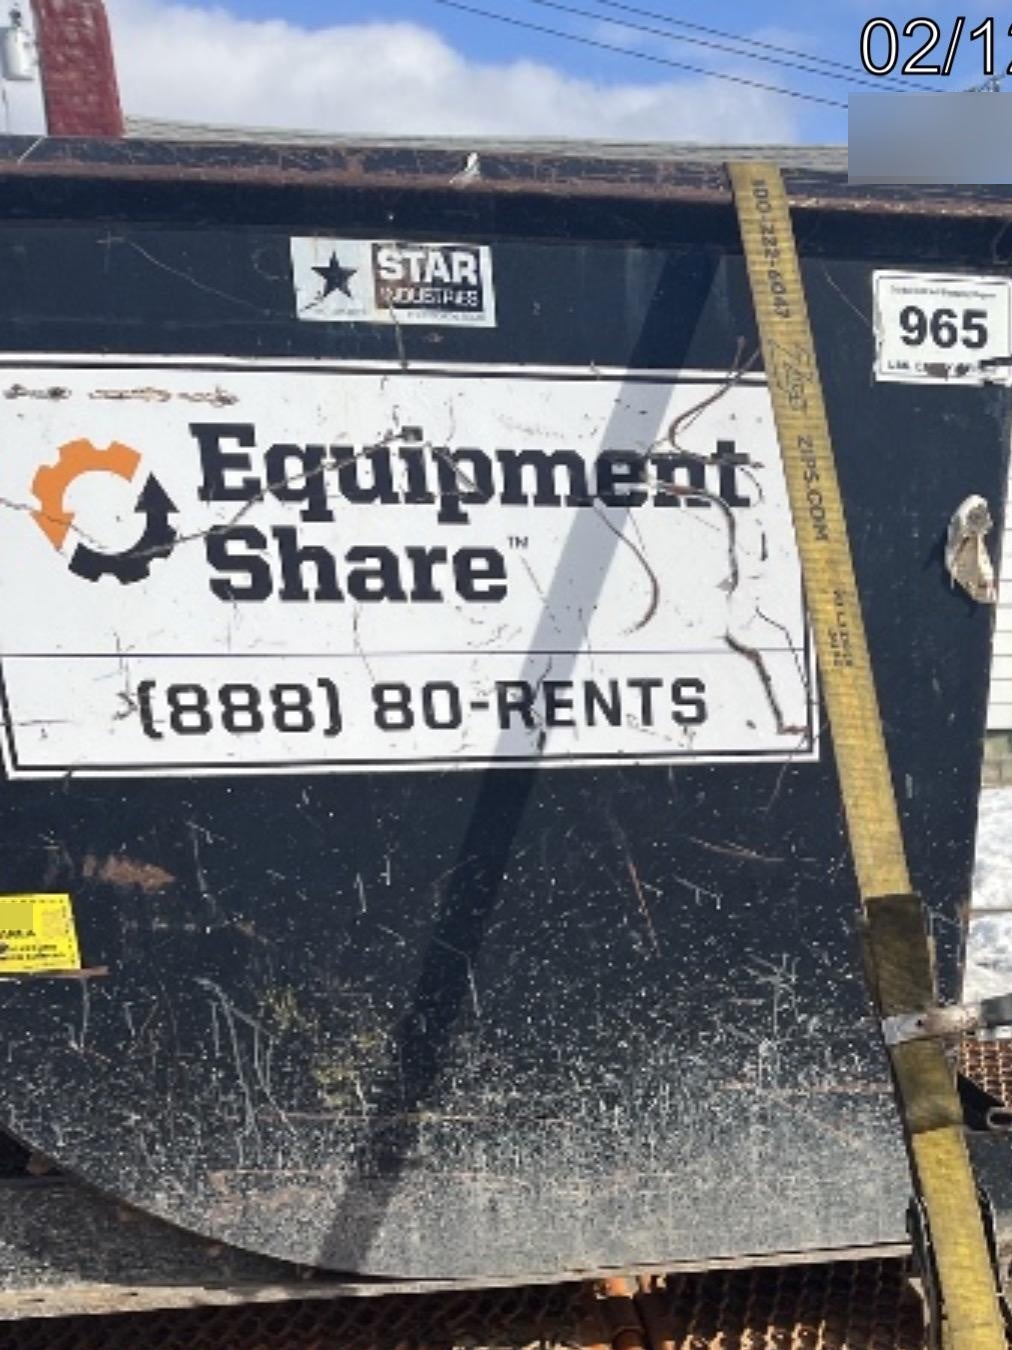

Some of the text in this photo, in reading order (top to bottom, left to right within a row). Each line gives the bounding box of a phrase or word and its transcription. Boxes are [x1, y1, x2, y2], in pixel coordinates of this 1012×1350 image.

[376, 248, 479, 286] STAR
[899, 304, 989, 349] 965
[190, 422, 752, 524] Equipment
[796, 435, 830, 542] ZIPS.COM
[205, 525, 508, 603] Share
[137, 678, 708, 740] (888) 80-RENTS
